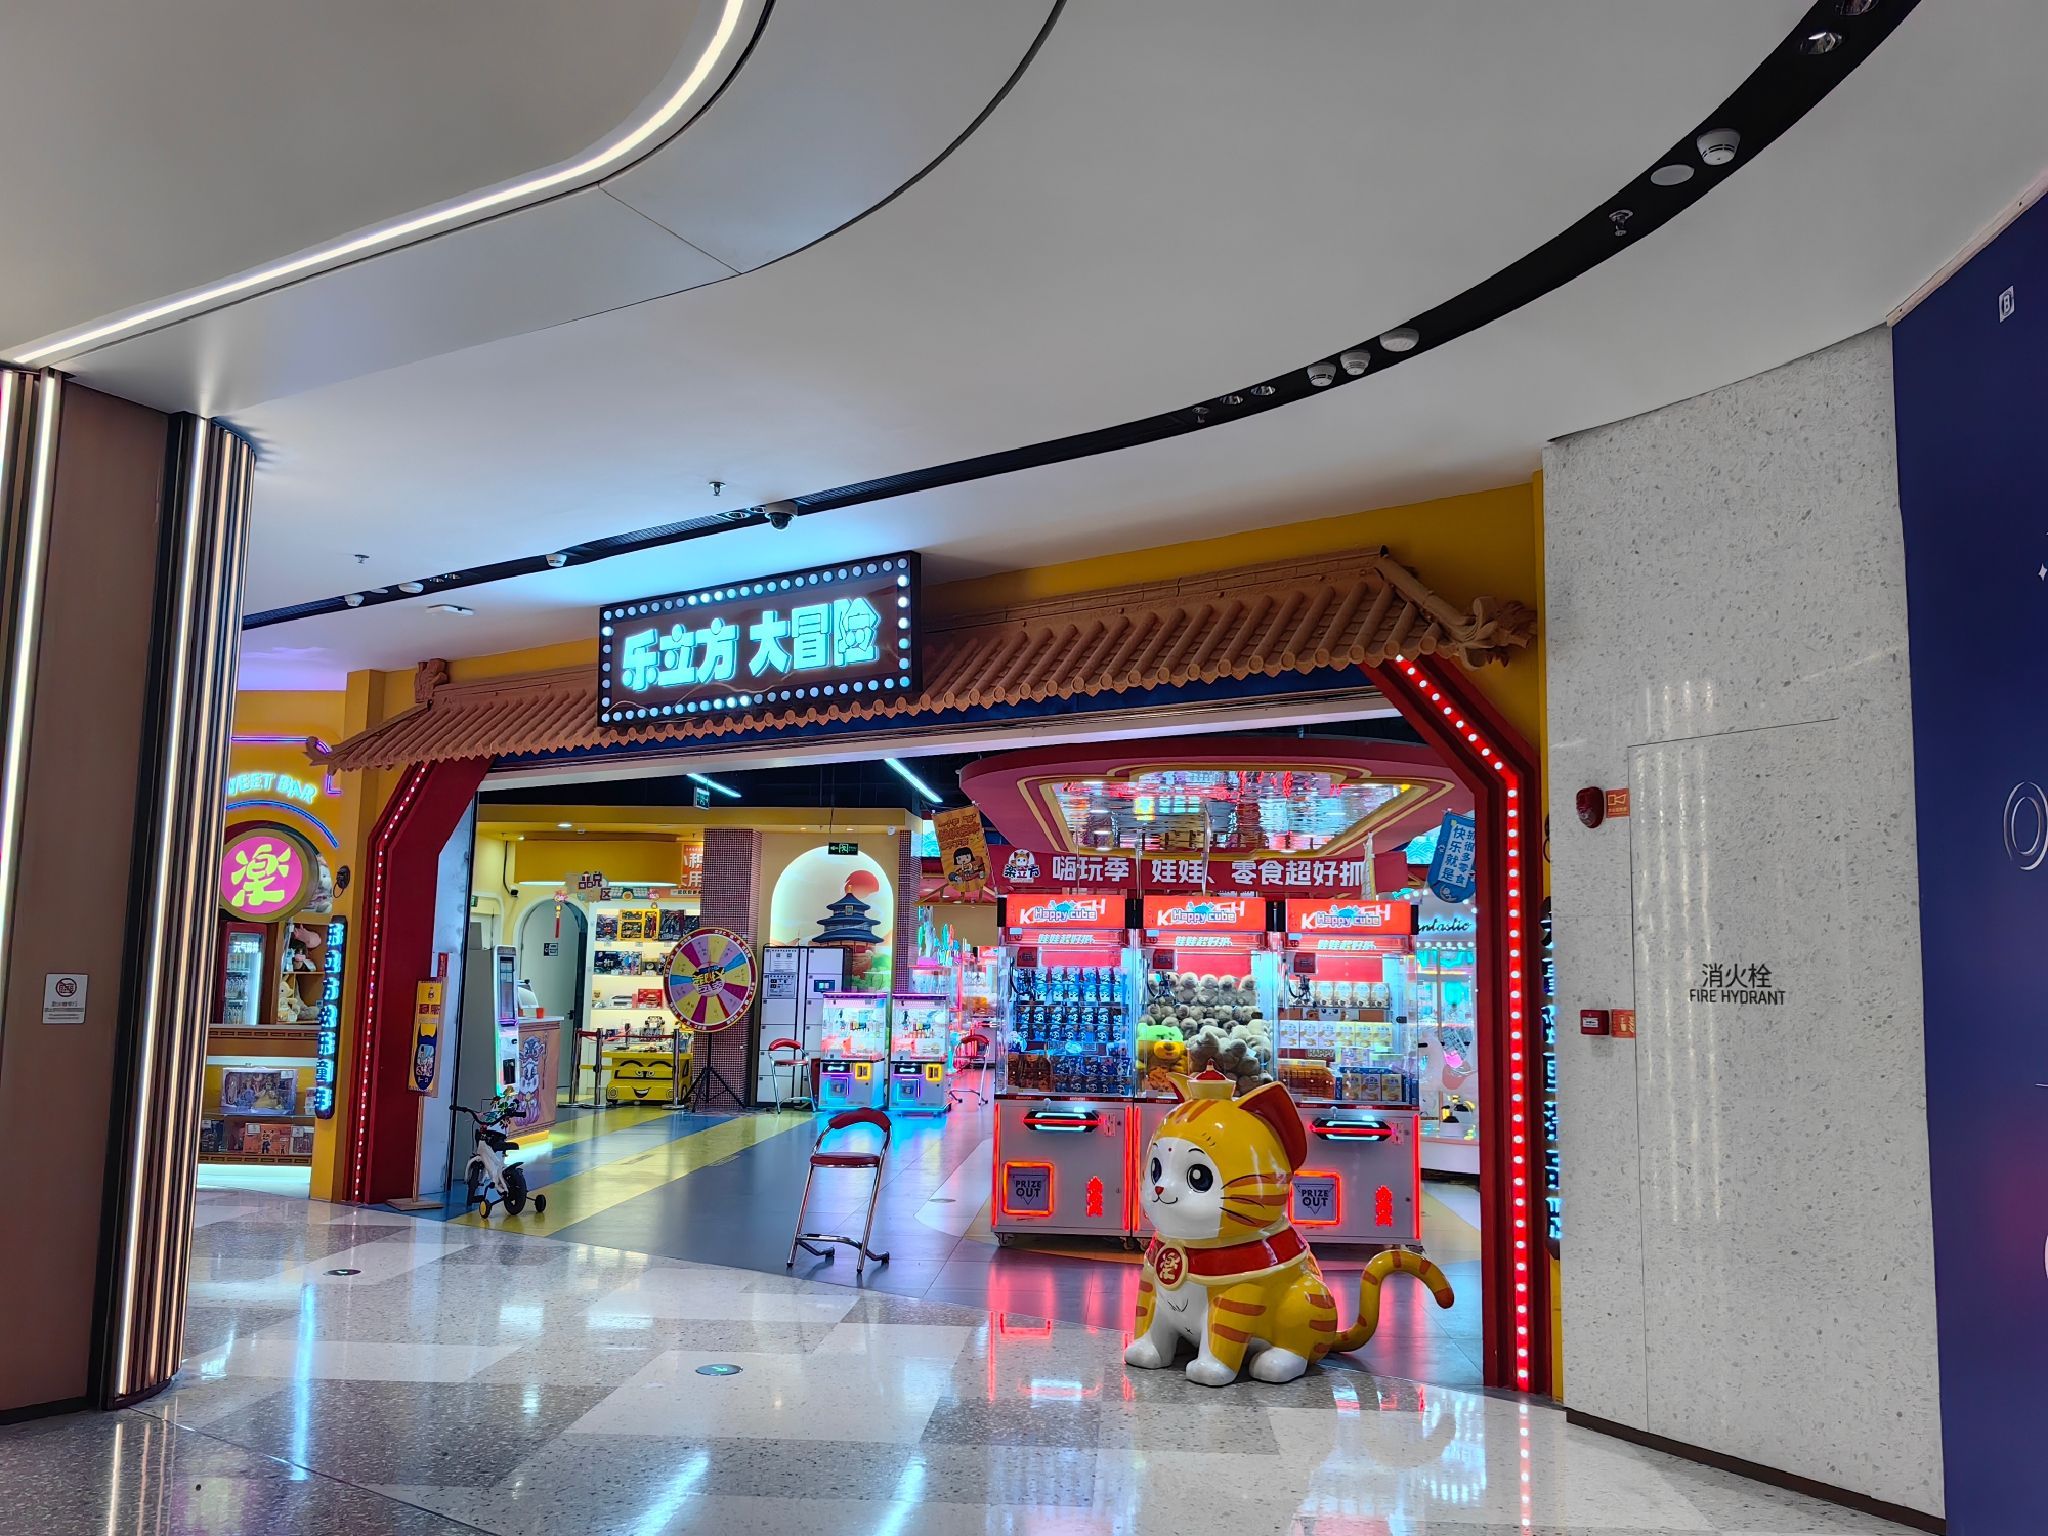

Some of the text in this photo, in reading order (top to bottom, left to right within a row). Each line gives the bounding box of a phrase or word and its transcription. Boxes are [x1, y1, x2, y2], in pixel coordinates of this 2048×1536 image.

[622, 597, 881, 692] 乐立方 大冒险
[227, 773, 317, 804] WEET BAR
[1441, 825, 1467, 882] 快乐就是
[1052, 856, 1130, 883] 嗨玩季
[1034, 906, 1068, 922] Happy
[1069, 907, 1097, 920] cube
[1171, 908, 1206, 923] Happy
[1207, 909, 1236, 922] cube
[1316, 911, 1352, 926] Happy
[1353, 912, 1381, 925] cube
[1702, 963, 1772, 988] 消火栓
[1689, 989, 1786, 1005] FIRE HYDRANT
[1015, 1180, 1042, 1188] PRIZE
[1016, 1187, 1041, 1197] OUT
[1301, 1189, 1329, 1198] PRIZE
[1302, 1197, 1329, 1207] OUT
